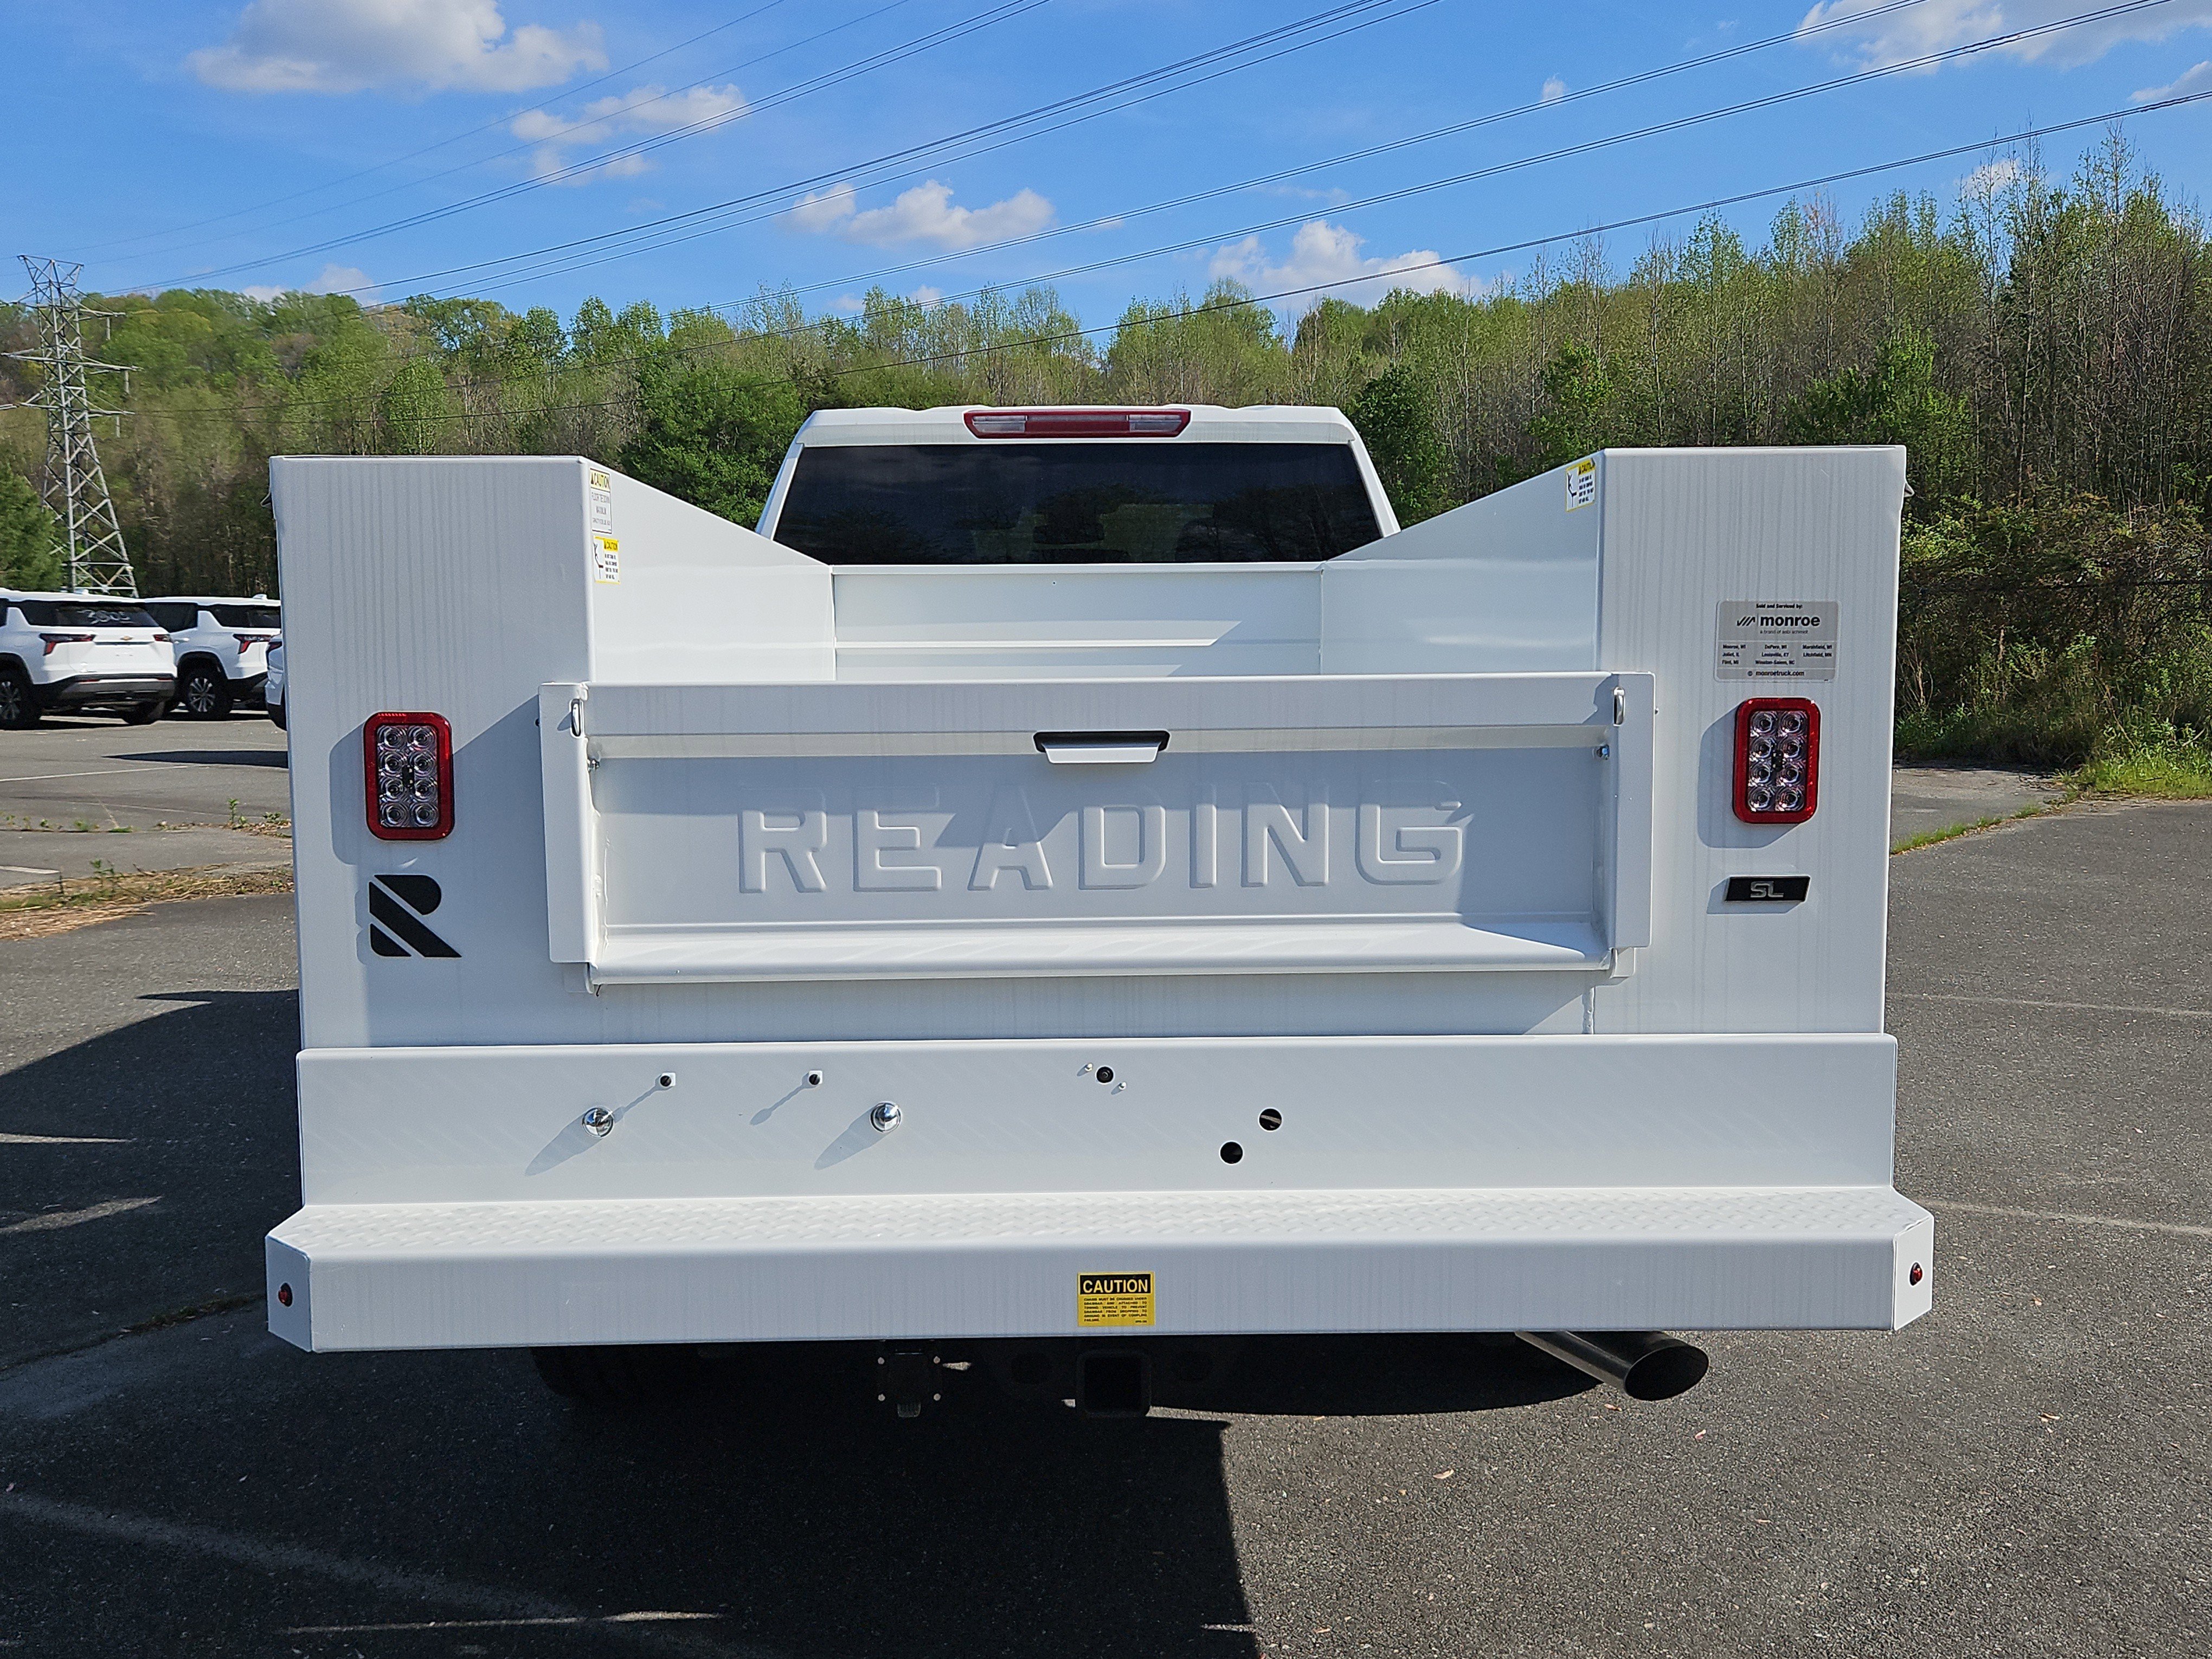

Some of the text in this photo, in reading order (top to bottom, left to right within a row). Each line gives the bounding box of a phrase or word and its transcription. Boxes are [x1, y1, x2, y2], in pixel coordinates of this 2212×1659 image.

[1760, 616, 1821, 626] monroe
[737, 780, 1463, 893] READING
[1750, 881, 1784, 898] SL
[1083, 1279, 1148, 1294] CAUTION
